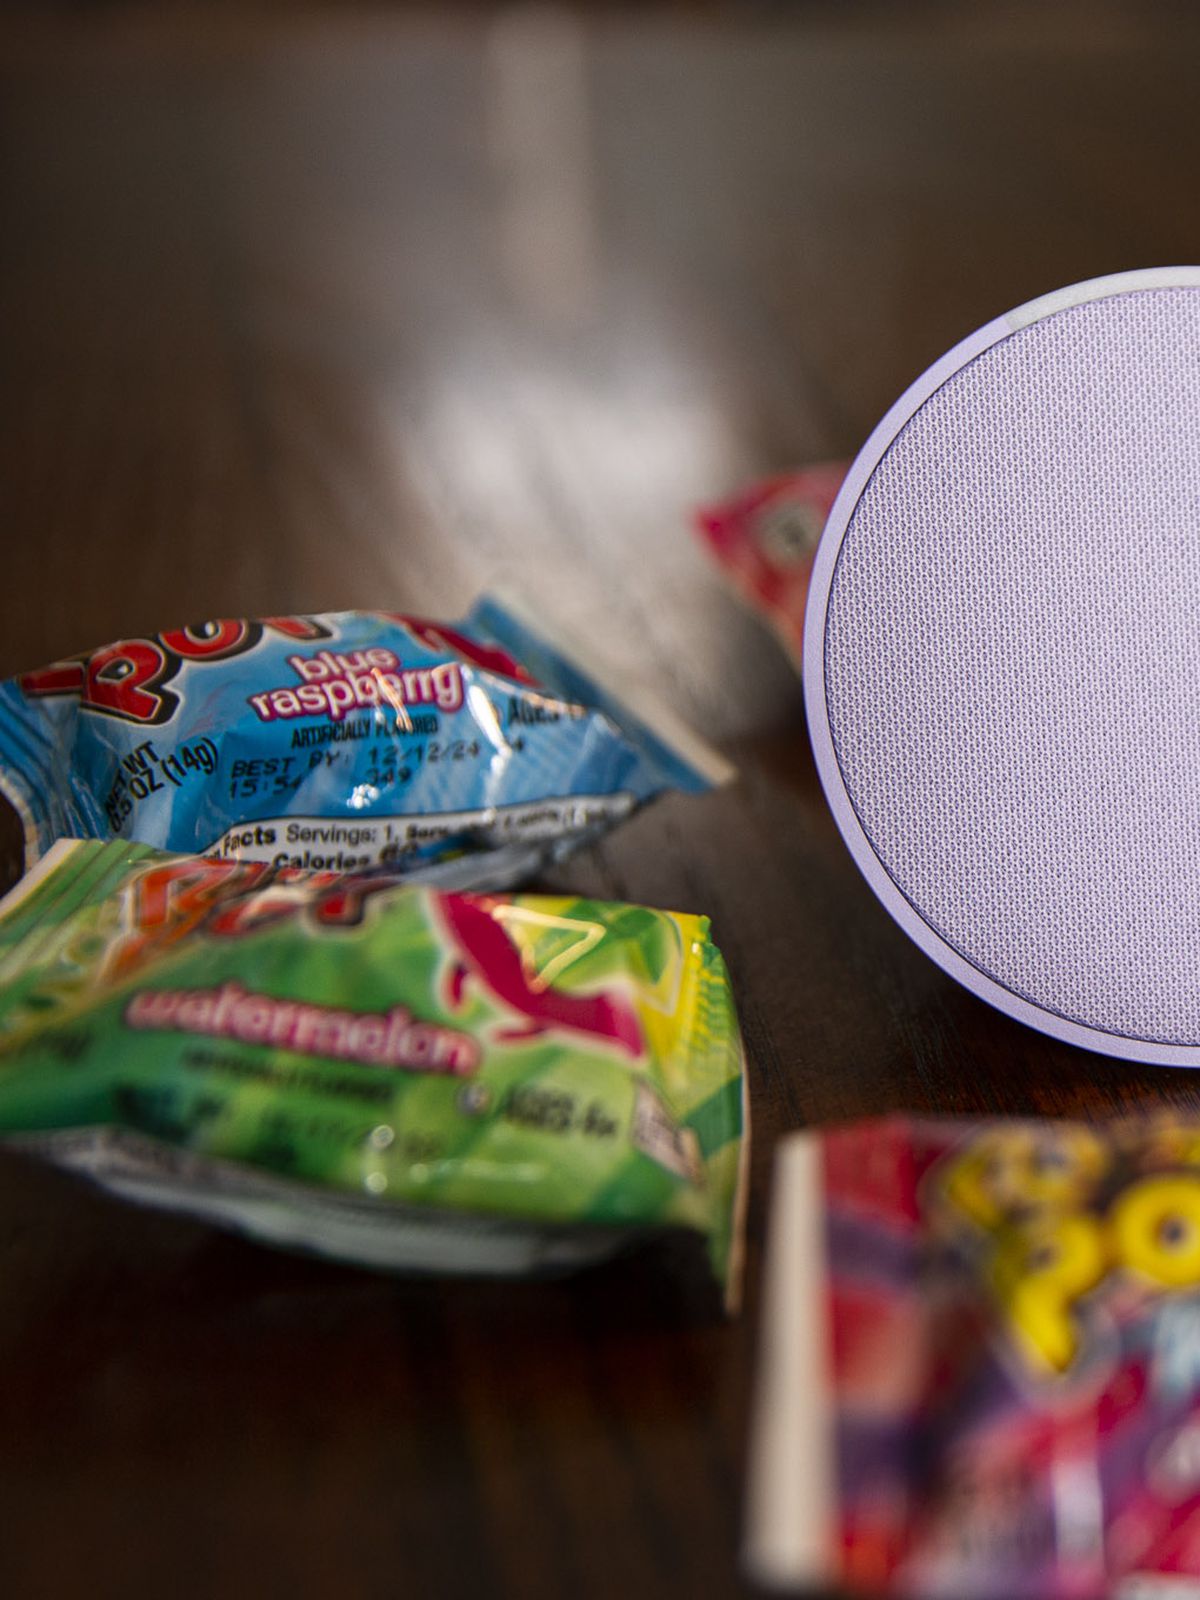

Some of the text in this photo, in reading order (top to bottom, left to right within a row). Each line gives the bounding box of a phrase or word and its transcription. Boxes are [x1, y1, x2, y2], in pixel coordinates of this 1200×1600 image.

[288, 648, 396, 682] blue
[249, 662, 463, 721] raspberry
[291, 719, 371, 749] ARTIFICIALLY
[122, 740, 159, 776] WT
[128, 768, 165, 800] OZ
[161, 737, 218, 787] (14g)
[231, 756, 296, 779] BEST
[286, 823, 376, 846] Servings:
[125, 983, 481, 1075] watermelon
